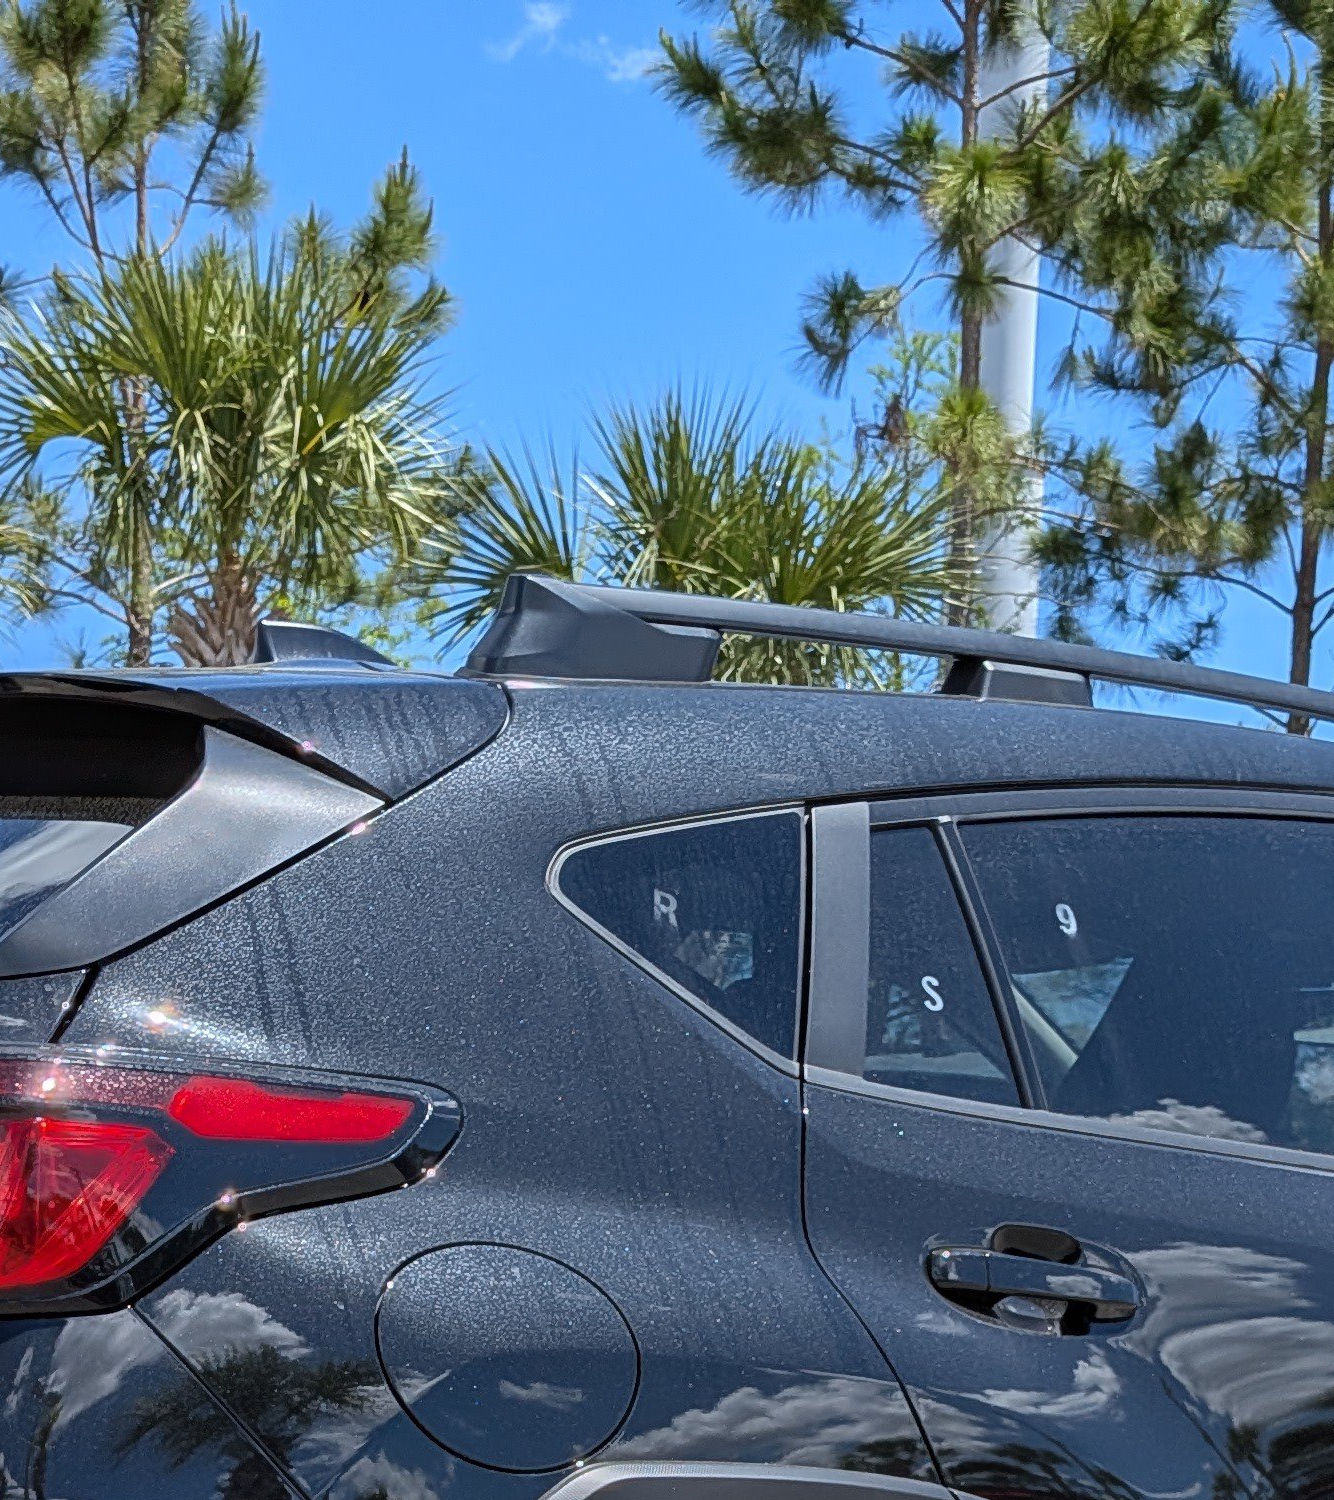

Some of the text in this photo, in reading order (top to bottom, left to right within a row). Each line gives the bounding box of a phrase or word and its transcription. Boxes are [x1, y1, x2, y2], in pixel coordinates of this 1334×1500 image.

[653, 888, 678, 930] R
[1054, 902, 1078, 938] 9
[920, 974, 945, 1012] S
